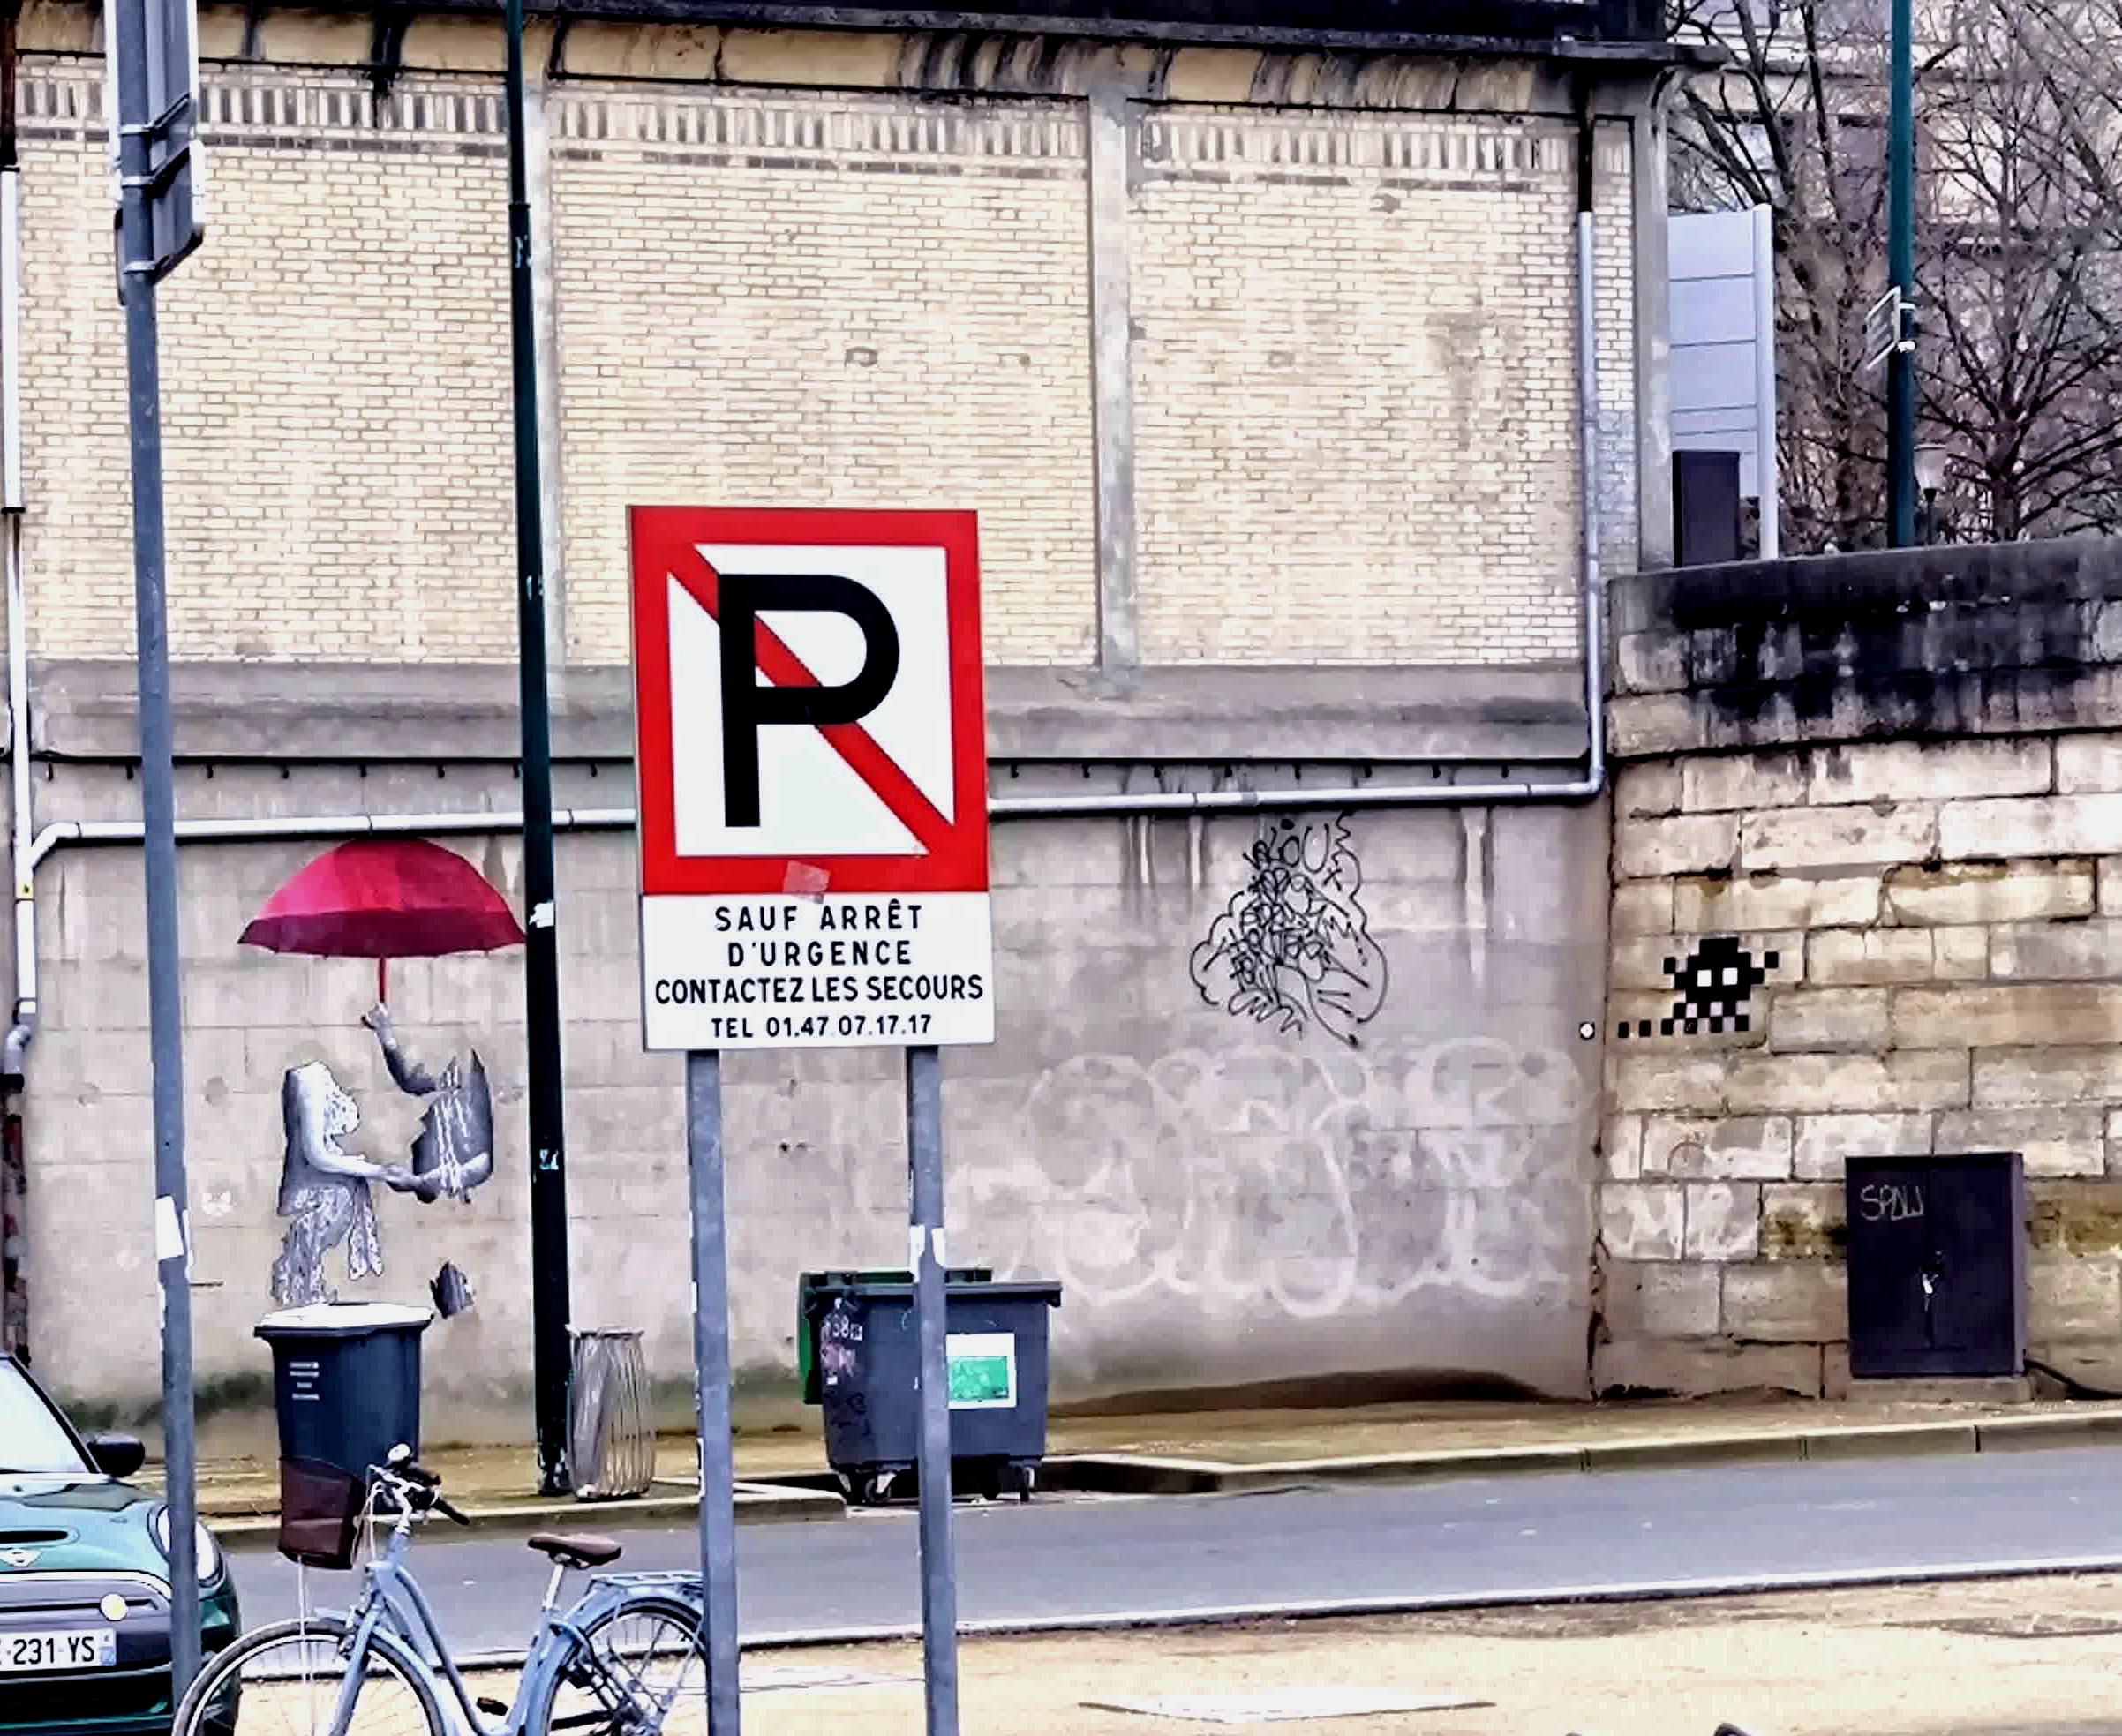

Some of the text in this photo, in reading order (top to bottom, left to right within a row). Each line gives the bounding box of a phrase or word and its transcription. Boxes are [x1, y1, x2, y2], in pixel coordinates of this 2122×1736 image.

[716, 573, 899, 827] P
[716, 898, 922, 931] SAUF ARRÊT
[728, 940, 911, 966] D'URGENCE
[655, 974, 983, 1004] CONTACTEZ LES SECOURS
[711, 1017, 753, 1038] TEL
